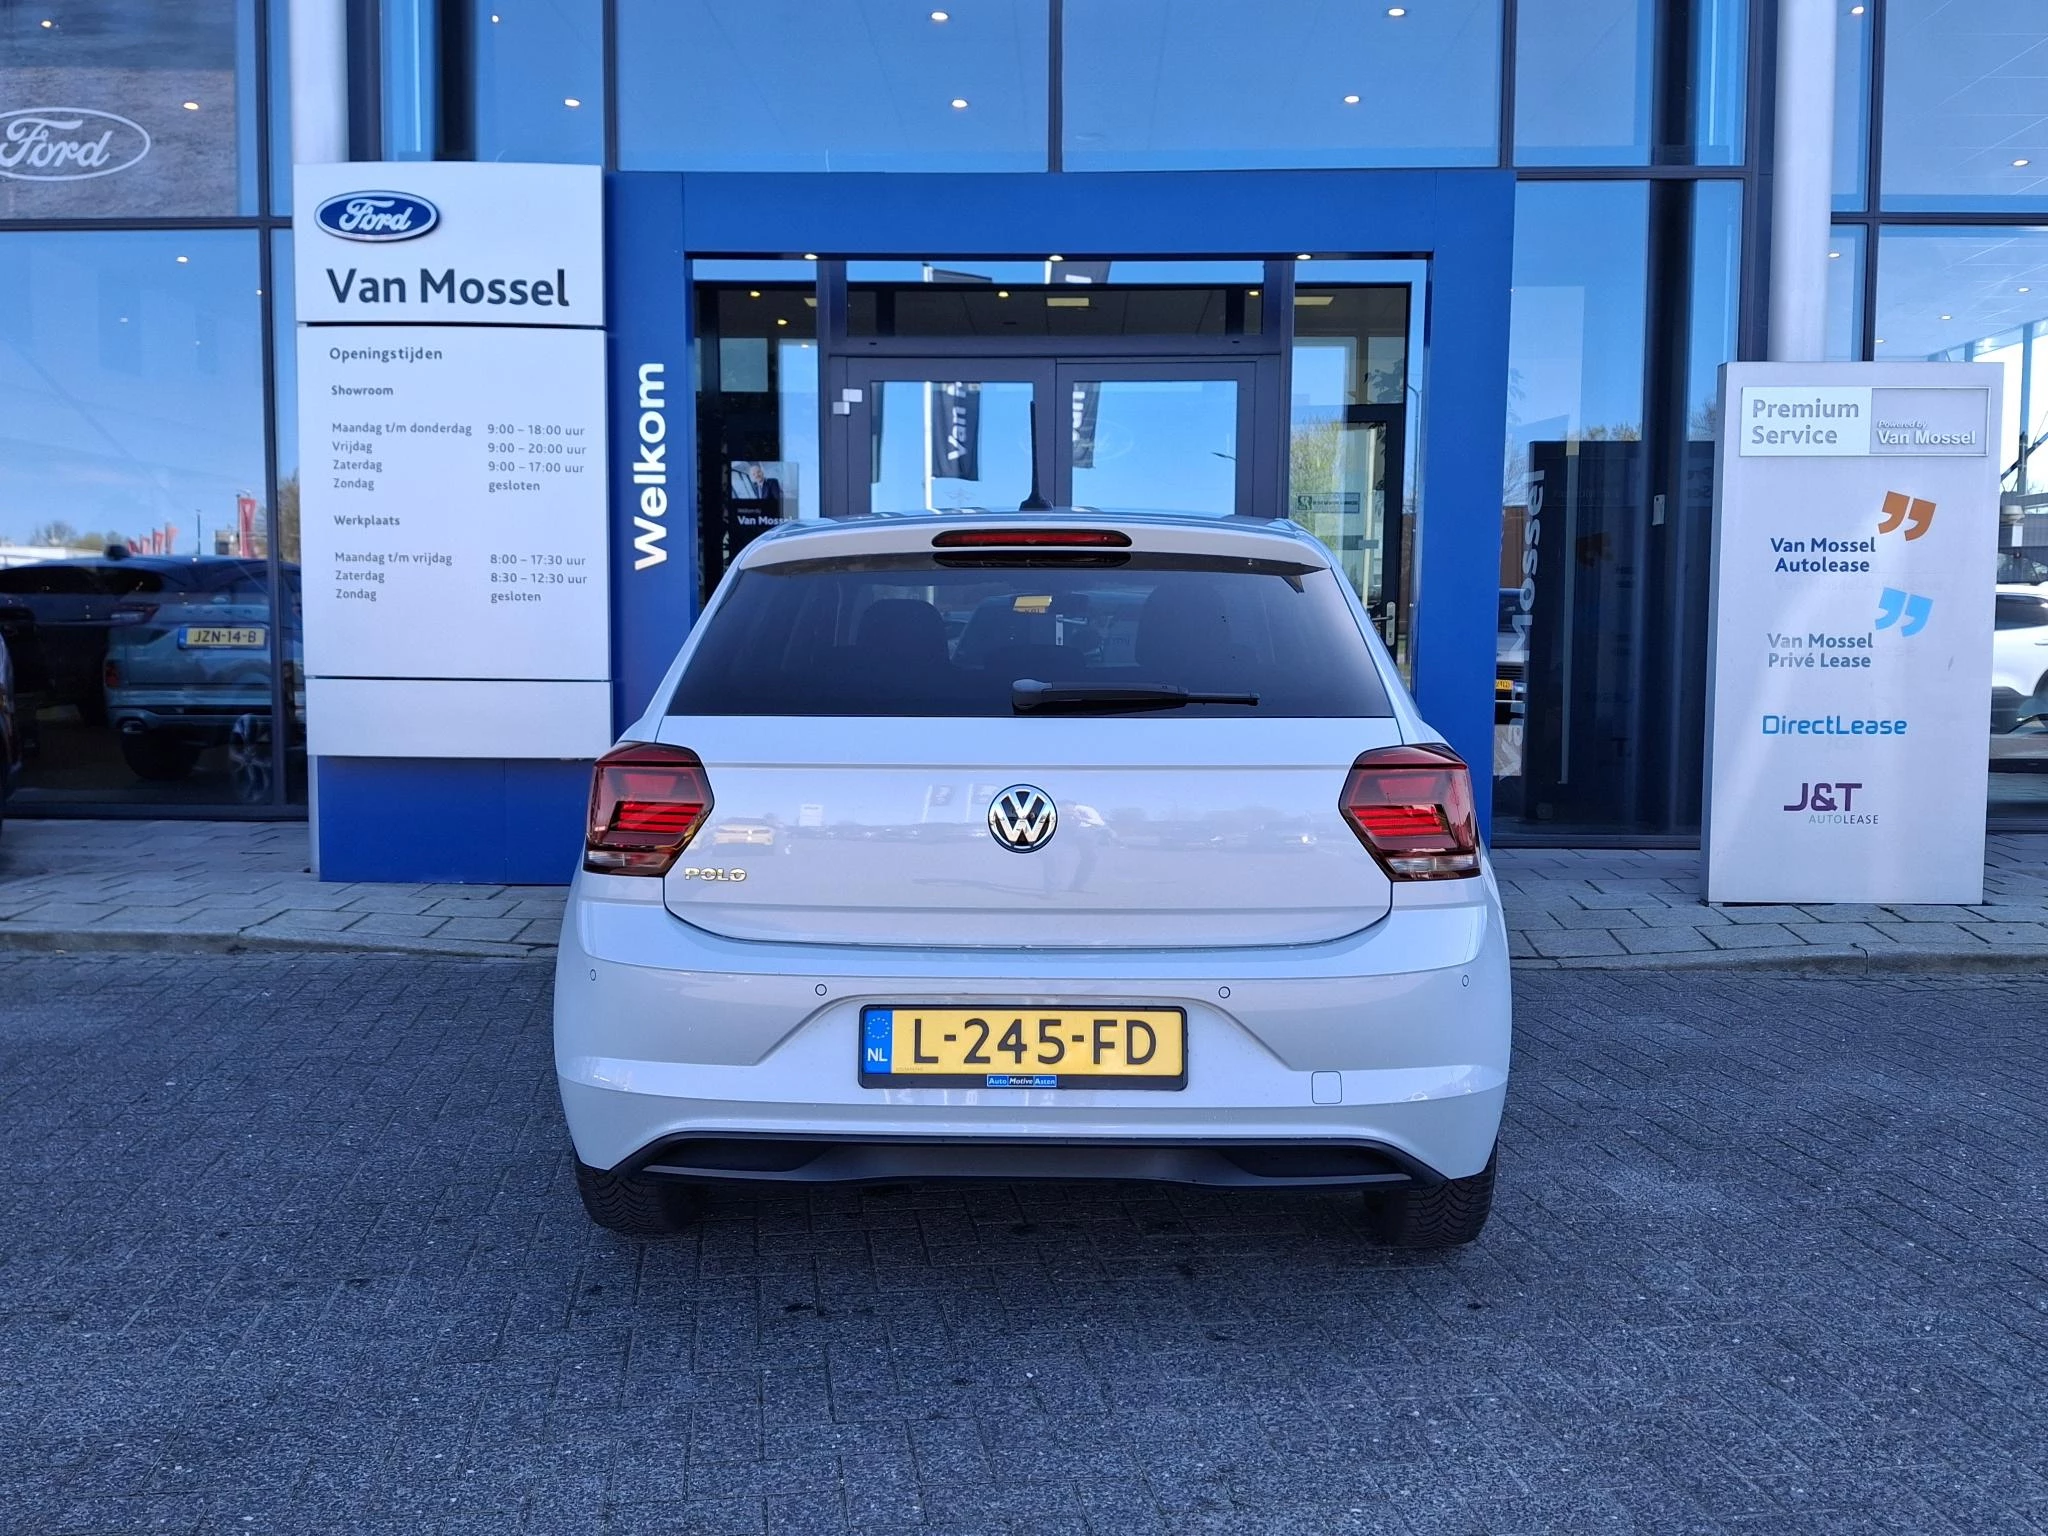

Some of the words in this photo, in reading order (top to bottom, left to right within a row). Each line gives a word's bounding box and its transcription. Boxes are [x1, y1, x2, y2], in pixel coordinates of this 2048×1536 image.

[0, 117, 113, 168] Ford
[339, 198, 412, 232] Ford
[326, 268, 406, 303] Van
[420, 268, 570, 306] Mossel
[329, 347, 443, 364] Openingstijden
[331, 385, 394, 396] Showroom
[1751, 398, 1859, 419] Premium
[332, 423, 382, 436] Maandag
[385, 423, 406, 434] t/m
[410, 423, 472, 436] donderdag
[487, 424, 515, 435] 9:00
[528, 424, 562, 436] 18:00
[565, 427, 585, 436] uur
[947, 406, 967, 460] Van
[1751, 425, 1838, 445] Service
[1877, 430, 1909, 445] Van
[1915, 430, 1976, 445] Mossel
[332, 441, 372, 454] Vrijdag
[487, 443, 515, 454] 9:00
[528, 443, 563, 455] 20:00
[566, 446, 586, 455] uur
[333, 460, 382, 472] Zaterdag
[488, 462, 515, 472] 9:00
[529, 461, 562, 473] 17:00
[564, 464, 584, 473] uur
[633, 363, 668, 571] Welkom
[333, 478, 375, 490] Zondag
[488, 481, 540, 493] gesloten
[334, 515, 400, 527] Werkplaats
[737, 515, 756, 525] Van
[1770, 537, 1805, 553] Van
[1811, 537, 1876, 553] Mossel
[335, 552, 385, 565] Maandag
[388, 552, 410, 563] t/m
[413, 552, 452, 566] vrijdag
[490, 555, 517, 565] 8:00
[531, 555, 562, 566] 17:30
[566, 557, 586, 566] uur
[1775, 557, 1870, 573] Autolease
[335, 570, 385, 583] Zaterdag
[490, 573, 517, 583] 8:30
[531, 573, 564, 584] 12:30
[567, 575, 587, 584] uur
[336, 588, 376, 601] Zondag
[491, 591, 541, 603] gesloten
[1767, 633, 1803, 648] Van
[1808, 632, 1873, 649] Mossel
[1768, 652, 1815, 668] Privé
[1820, 652, 1871, 668] Lease
[1763, 715, 1908, 735] DirectLease
[1784, 782, 1862, 812] J&T
[684, 867, 747, 883] POLO
[866, 1047, 888, 1063] NL
[914, 1018, 1157, 1066] L-245-FD
[988, 1077, 1007, 1085] Auto
[1009, 1077, 1033, 1085] Motive
